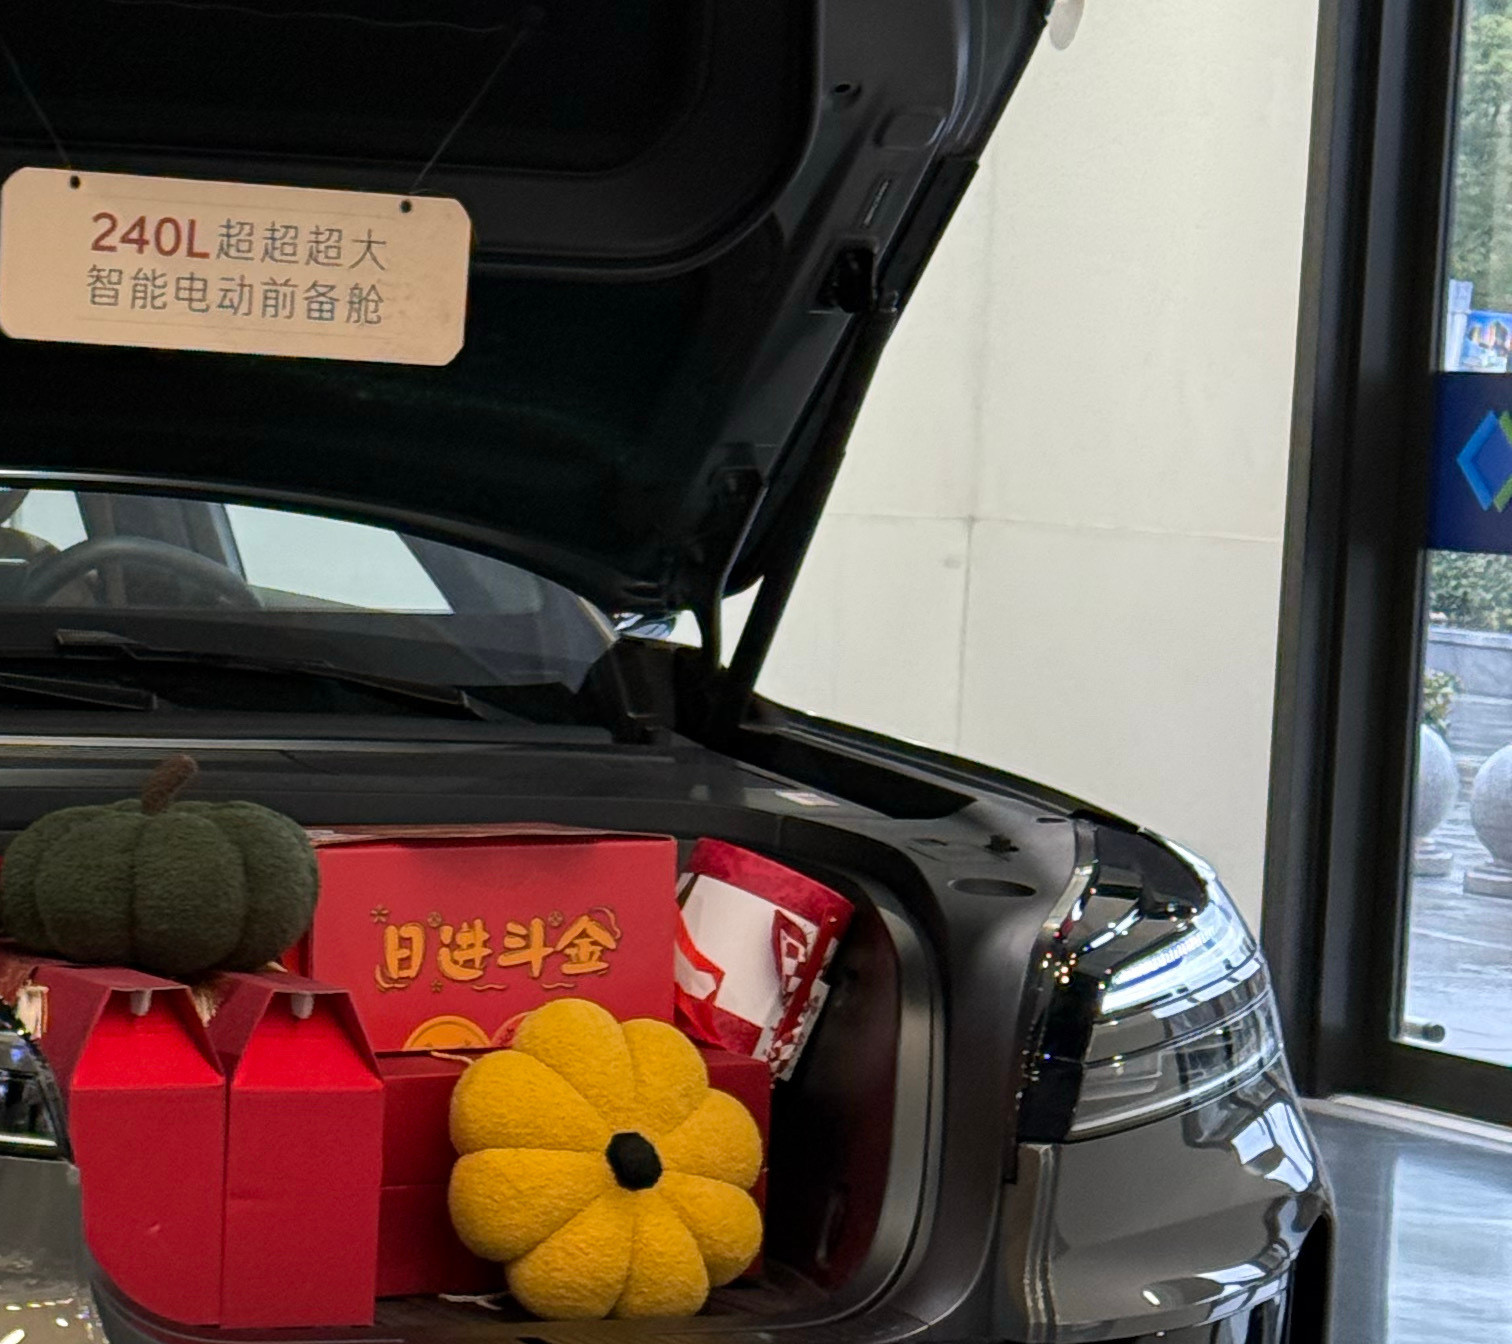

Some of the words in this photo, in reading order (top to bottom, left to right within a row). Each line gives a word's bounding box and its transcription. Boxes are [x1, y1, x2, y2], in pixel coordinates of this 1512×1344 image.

[90, 211, 388, 272] 240L超超超大
[86, 263, 385, 327] 智能电动前备舱
[383, 914, 617, 981] 日进斗金
